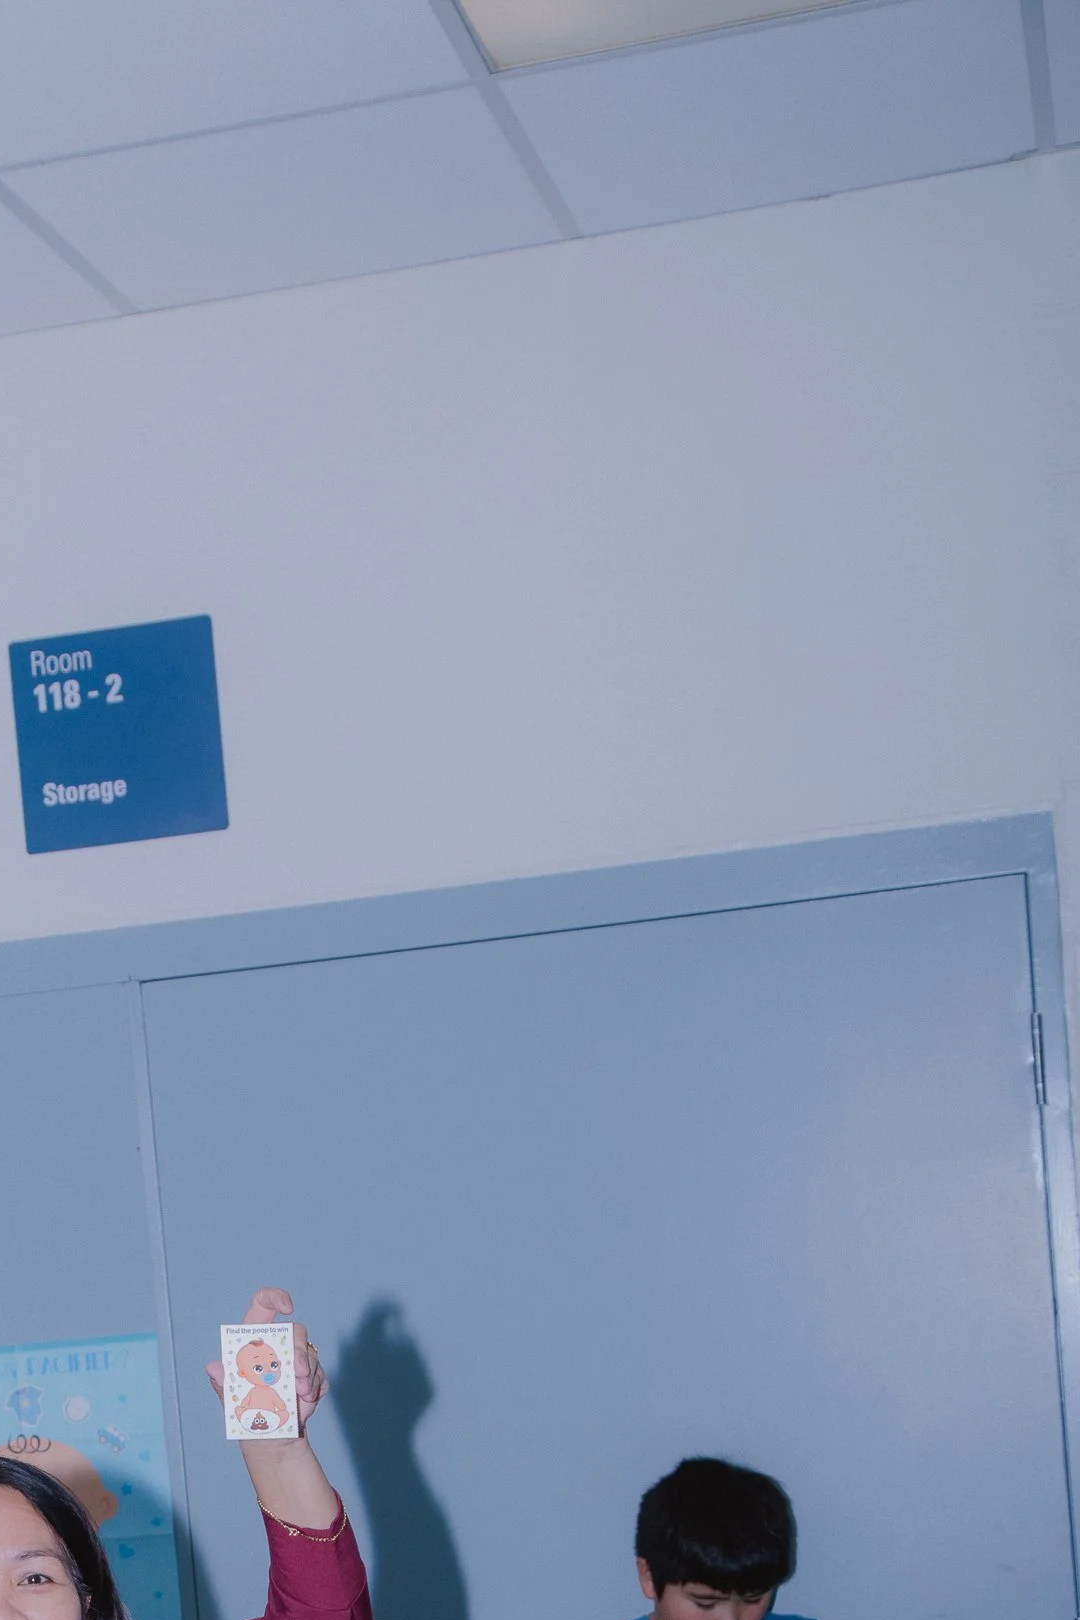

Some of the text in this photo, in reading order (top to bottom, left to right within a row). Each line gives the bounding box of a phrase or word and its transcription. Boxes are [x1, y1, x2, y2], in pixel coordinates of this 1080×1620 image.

[30, 650, 92, 677] Room
[33, 679, 82, 713] 118
[105, 673, 124, 704] 2
[42, 779, 127, 807] Storage
